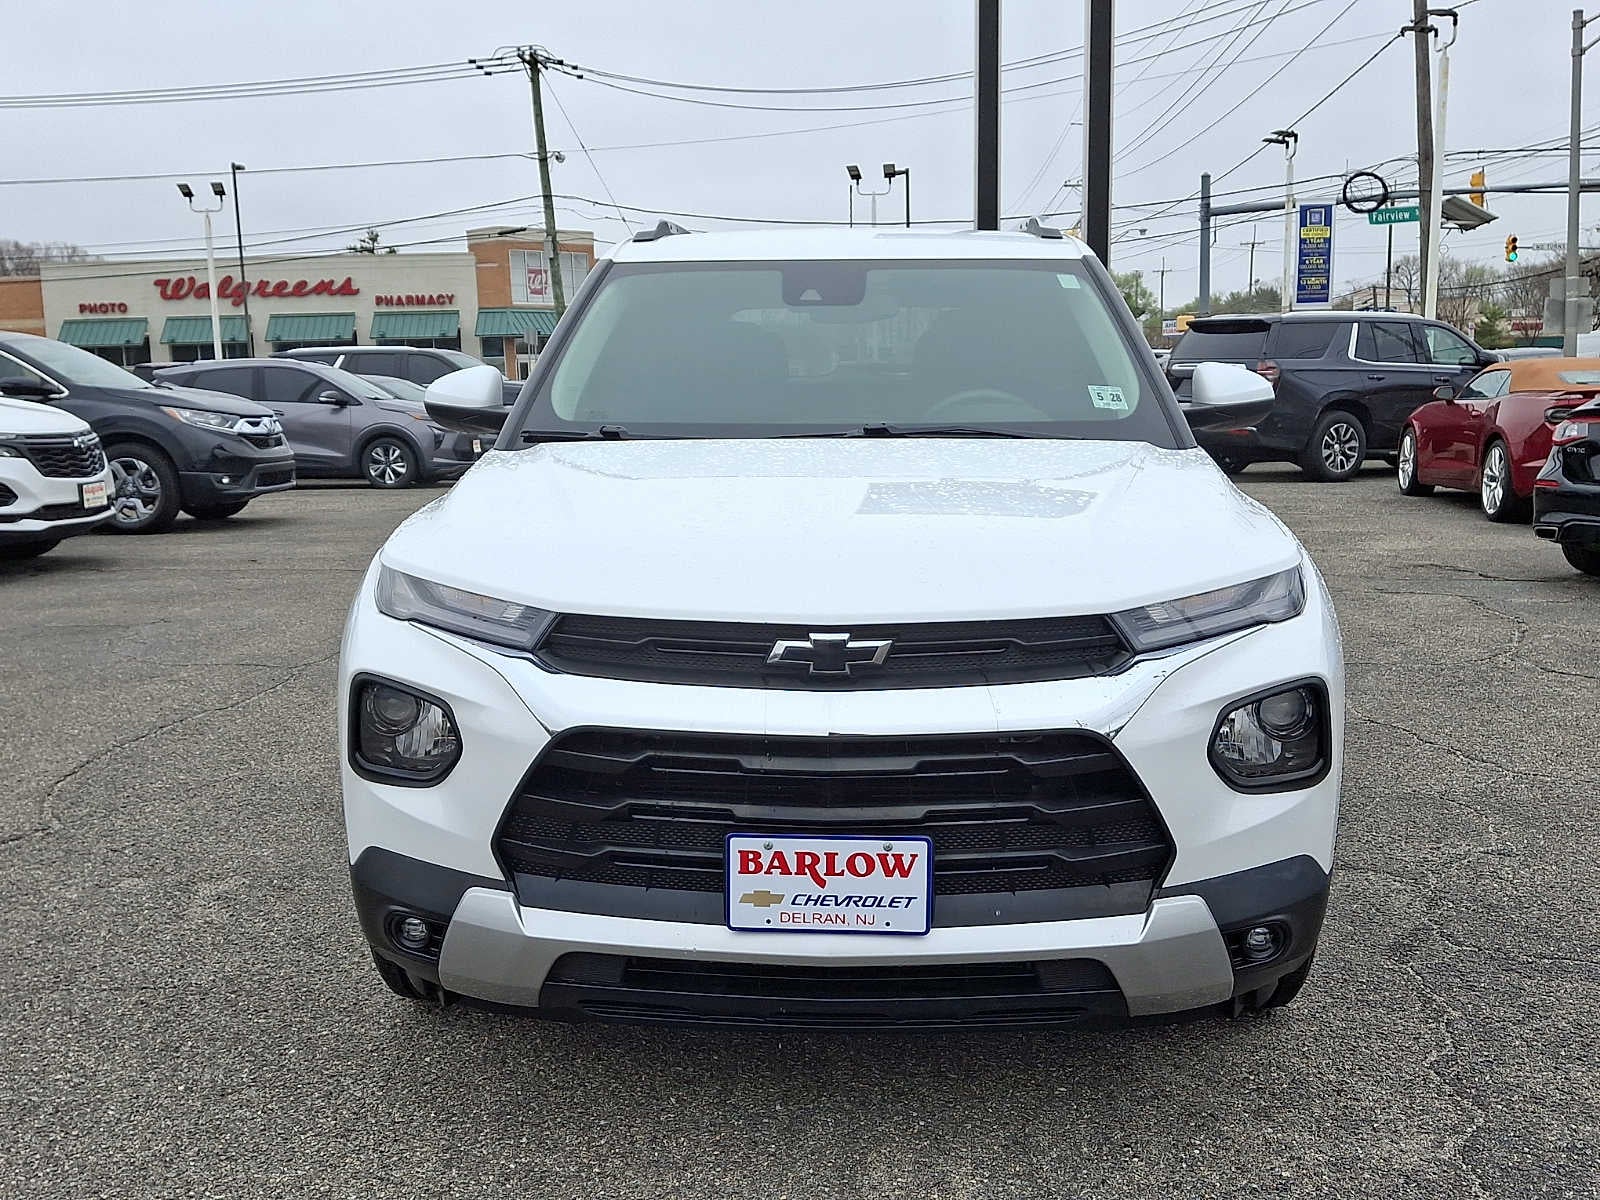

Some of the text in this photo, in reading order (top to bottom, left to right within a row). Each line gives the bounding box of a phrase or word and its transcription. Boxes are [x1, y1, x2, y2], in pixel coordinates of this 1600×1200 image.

[1372, 210, 1410, 222] Fairview
[153, 275, 360, 307] Walgreens
[375, 293, 455, 306] PHARMACY
[79, 302, 128, 313] PHOTO
[1096, 392, 1122, 402] 5 28
[738, 850, 918, 888] BARLOW
[791, 893, 917, 908] CHEVROLET
[780, 912, 876, 926] DELRAN, NJ
